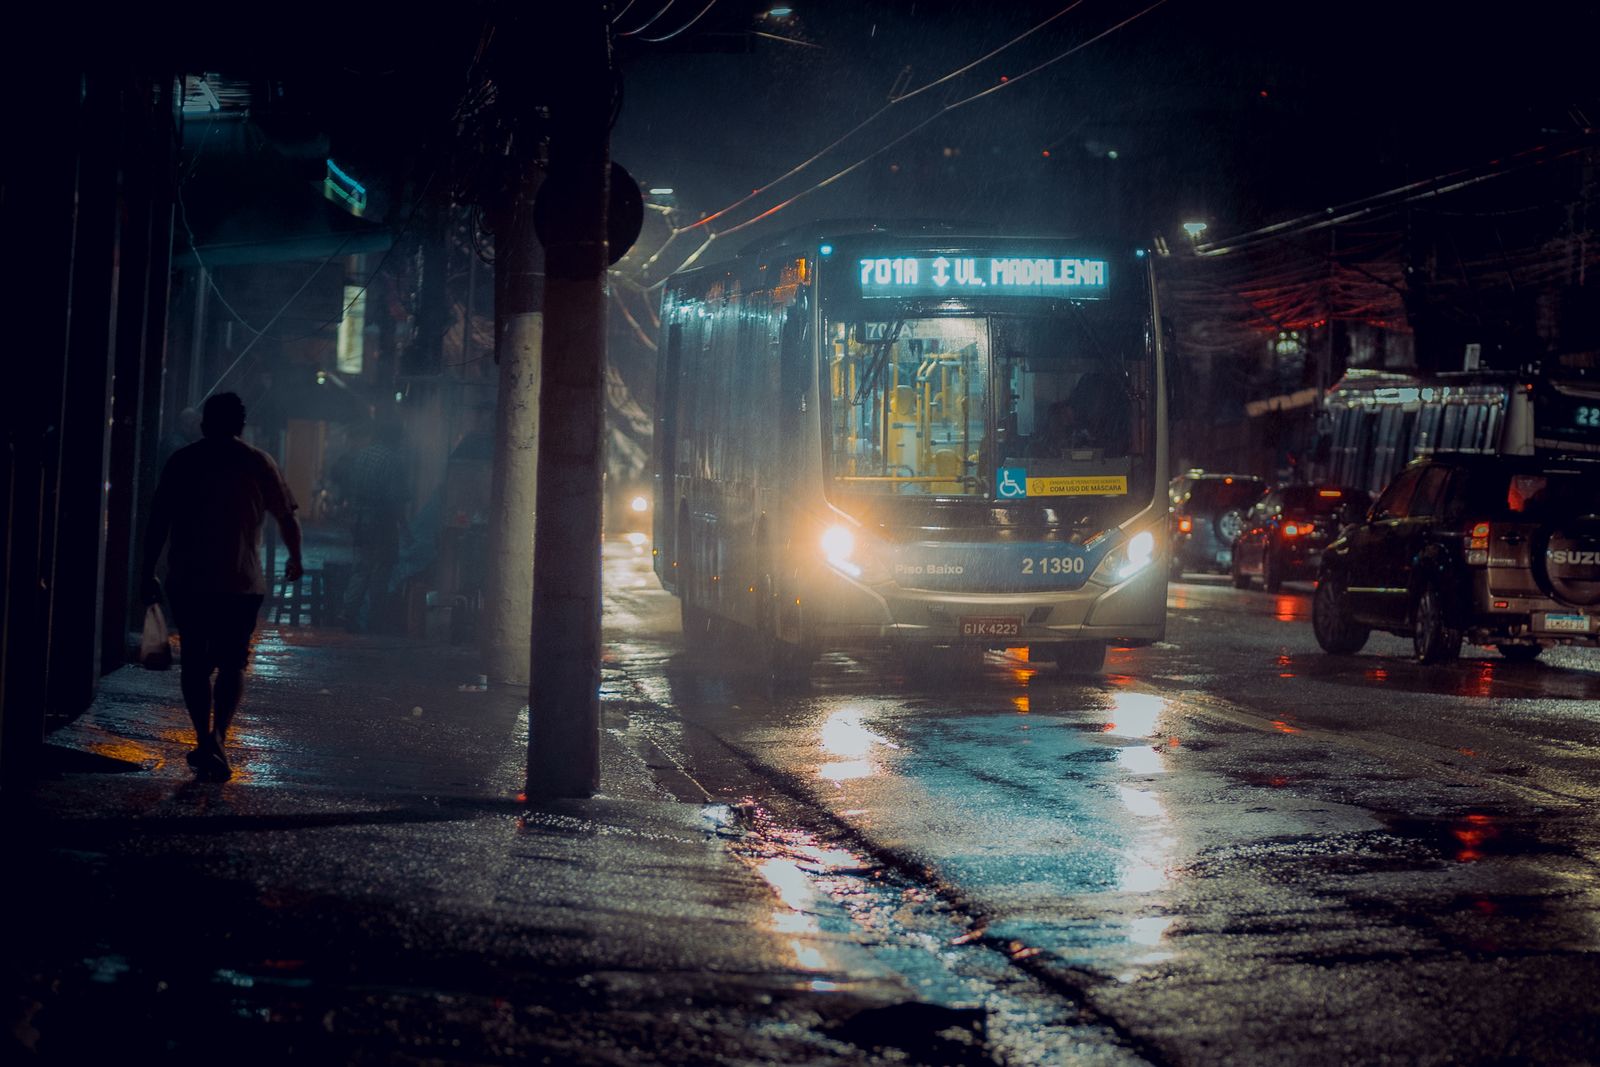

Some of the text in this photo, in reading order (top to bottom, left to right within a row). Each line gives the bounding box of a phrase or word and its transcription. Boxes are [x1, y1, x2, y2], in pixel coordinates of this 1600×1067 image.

[861, 259, 918, 284] 701A
[991, 259, 1104, 285] MADALENA
[896, 564, 963, 574] Piso Baixo
[1039, 557, 1084, 573] 1390
